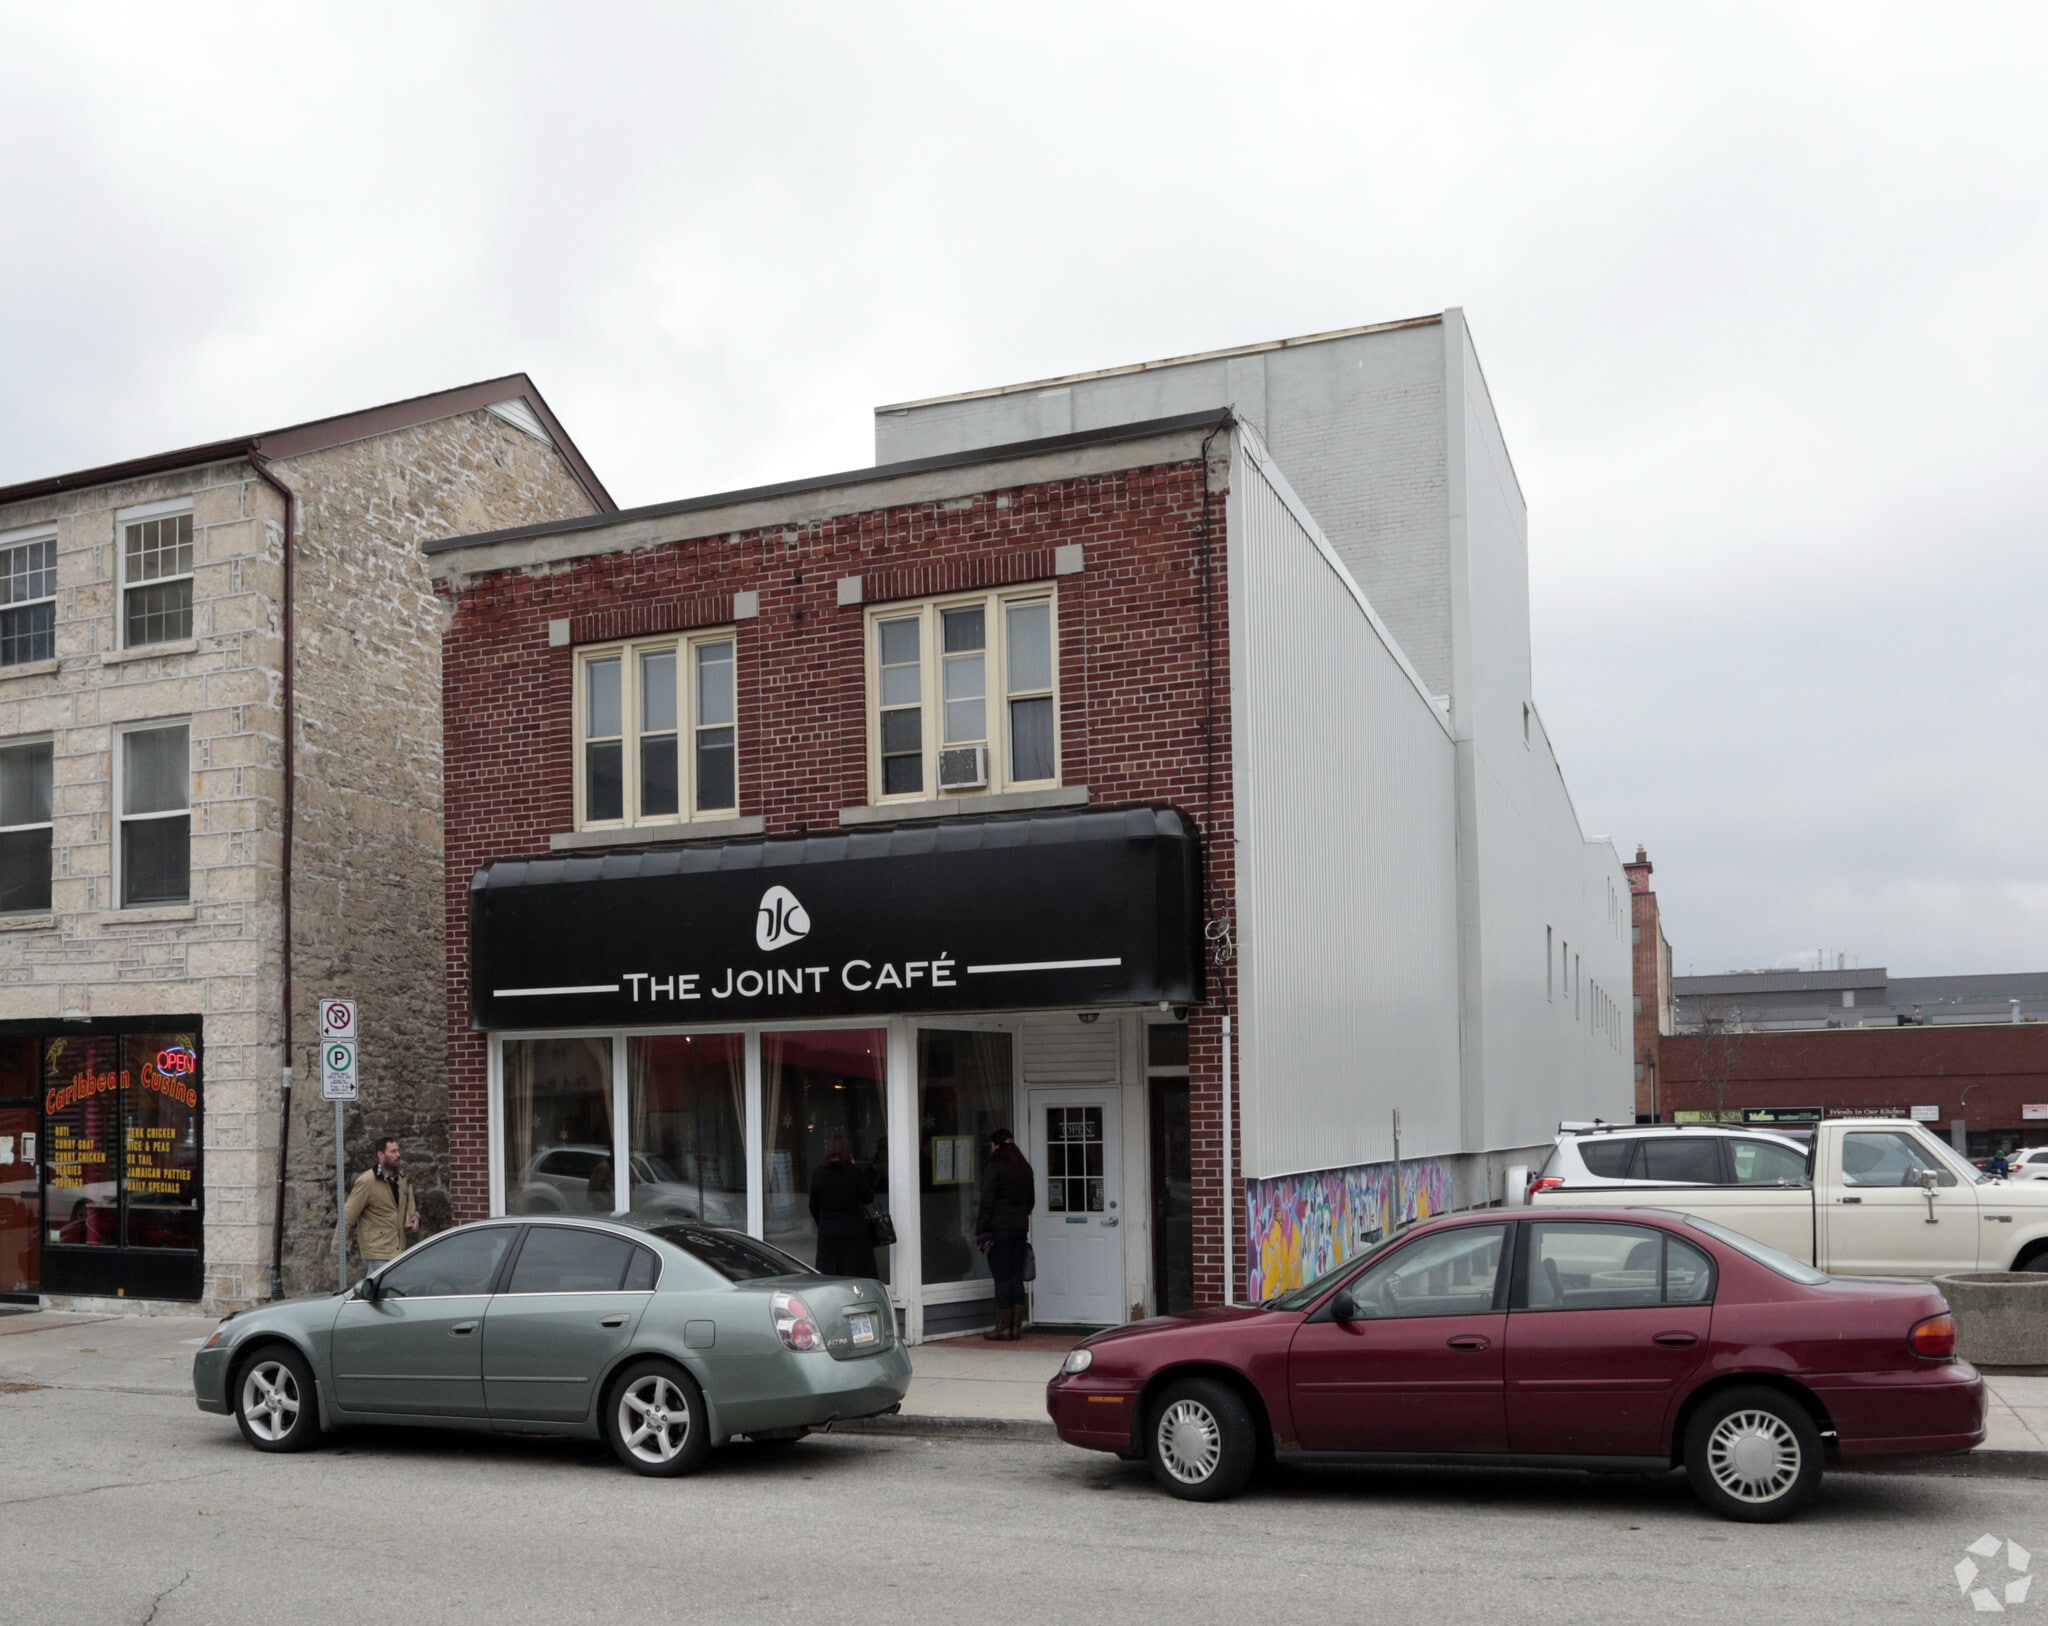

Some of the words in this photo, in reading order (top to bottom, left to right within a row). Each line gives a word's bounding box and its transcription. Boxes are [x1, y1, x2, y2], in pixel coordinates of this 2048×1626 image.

[623, 973, 701, 1002] THE
[711, 967, 830, 999] JOINT
[841, 951, 957, 992] CAFÉ
[156, 1051, 194, 1073] OPEN
[334, 1050, 345, 1065] P
[45, 1068, 130, 1115] Caribbean
[140, 1062, 197, 1108] Cusine
[146, 1128, 176, 1139] CHICKEN
[1061, 1125, 1093, 1135] OPEN
[152, 1141, 170, 1152] PEAS
[78, 1152, 106, 1163] CHICKEN
[138, 1154, 153, 1166] TAIL
[127, 1167, 161, 1178] JAMAICAN
[163, 1168, 191, 1180] PATTIES
[127, 1181, 146, 1192] DAILY
[148, 1181, 180, 1193] SPECIALS
